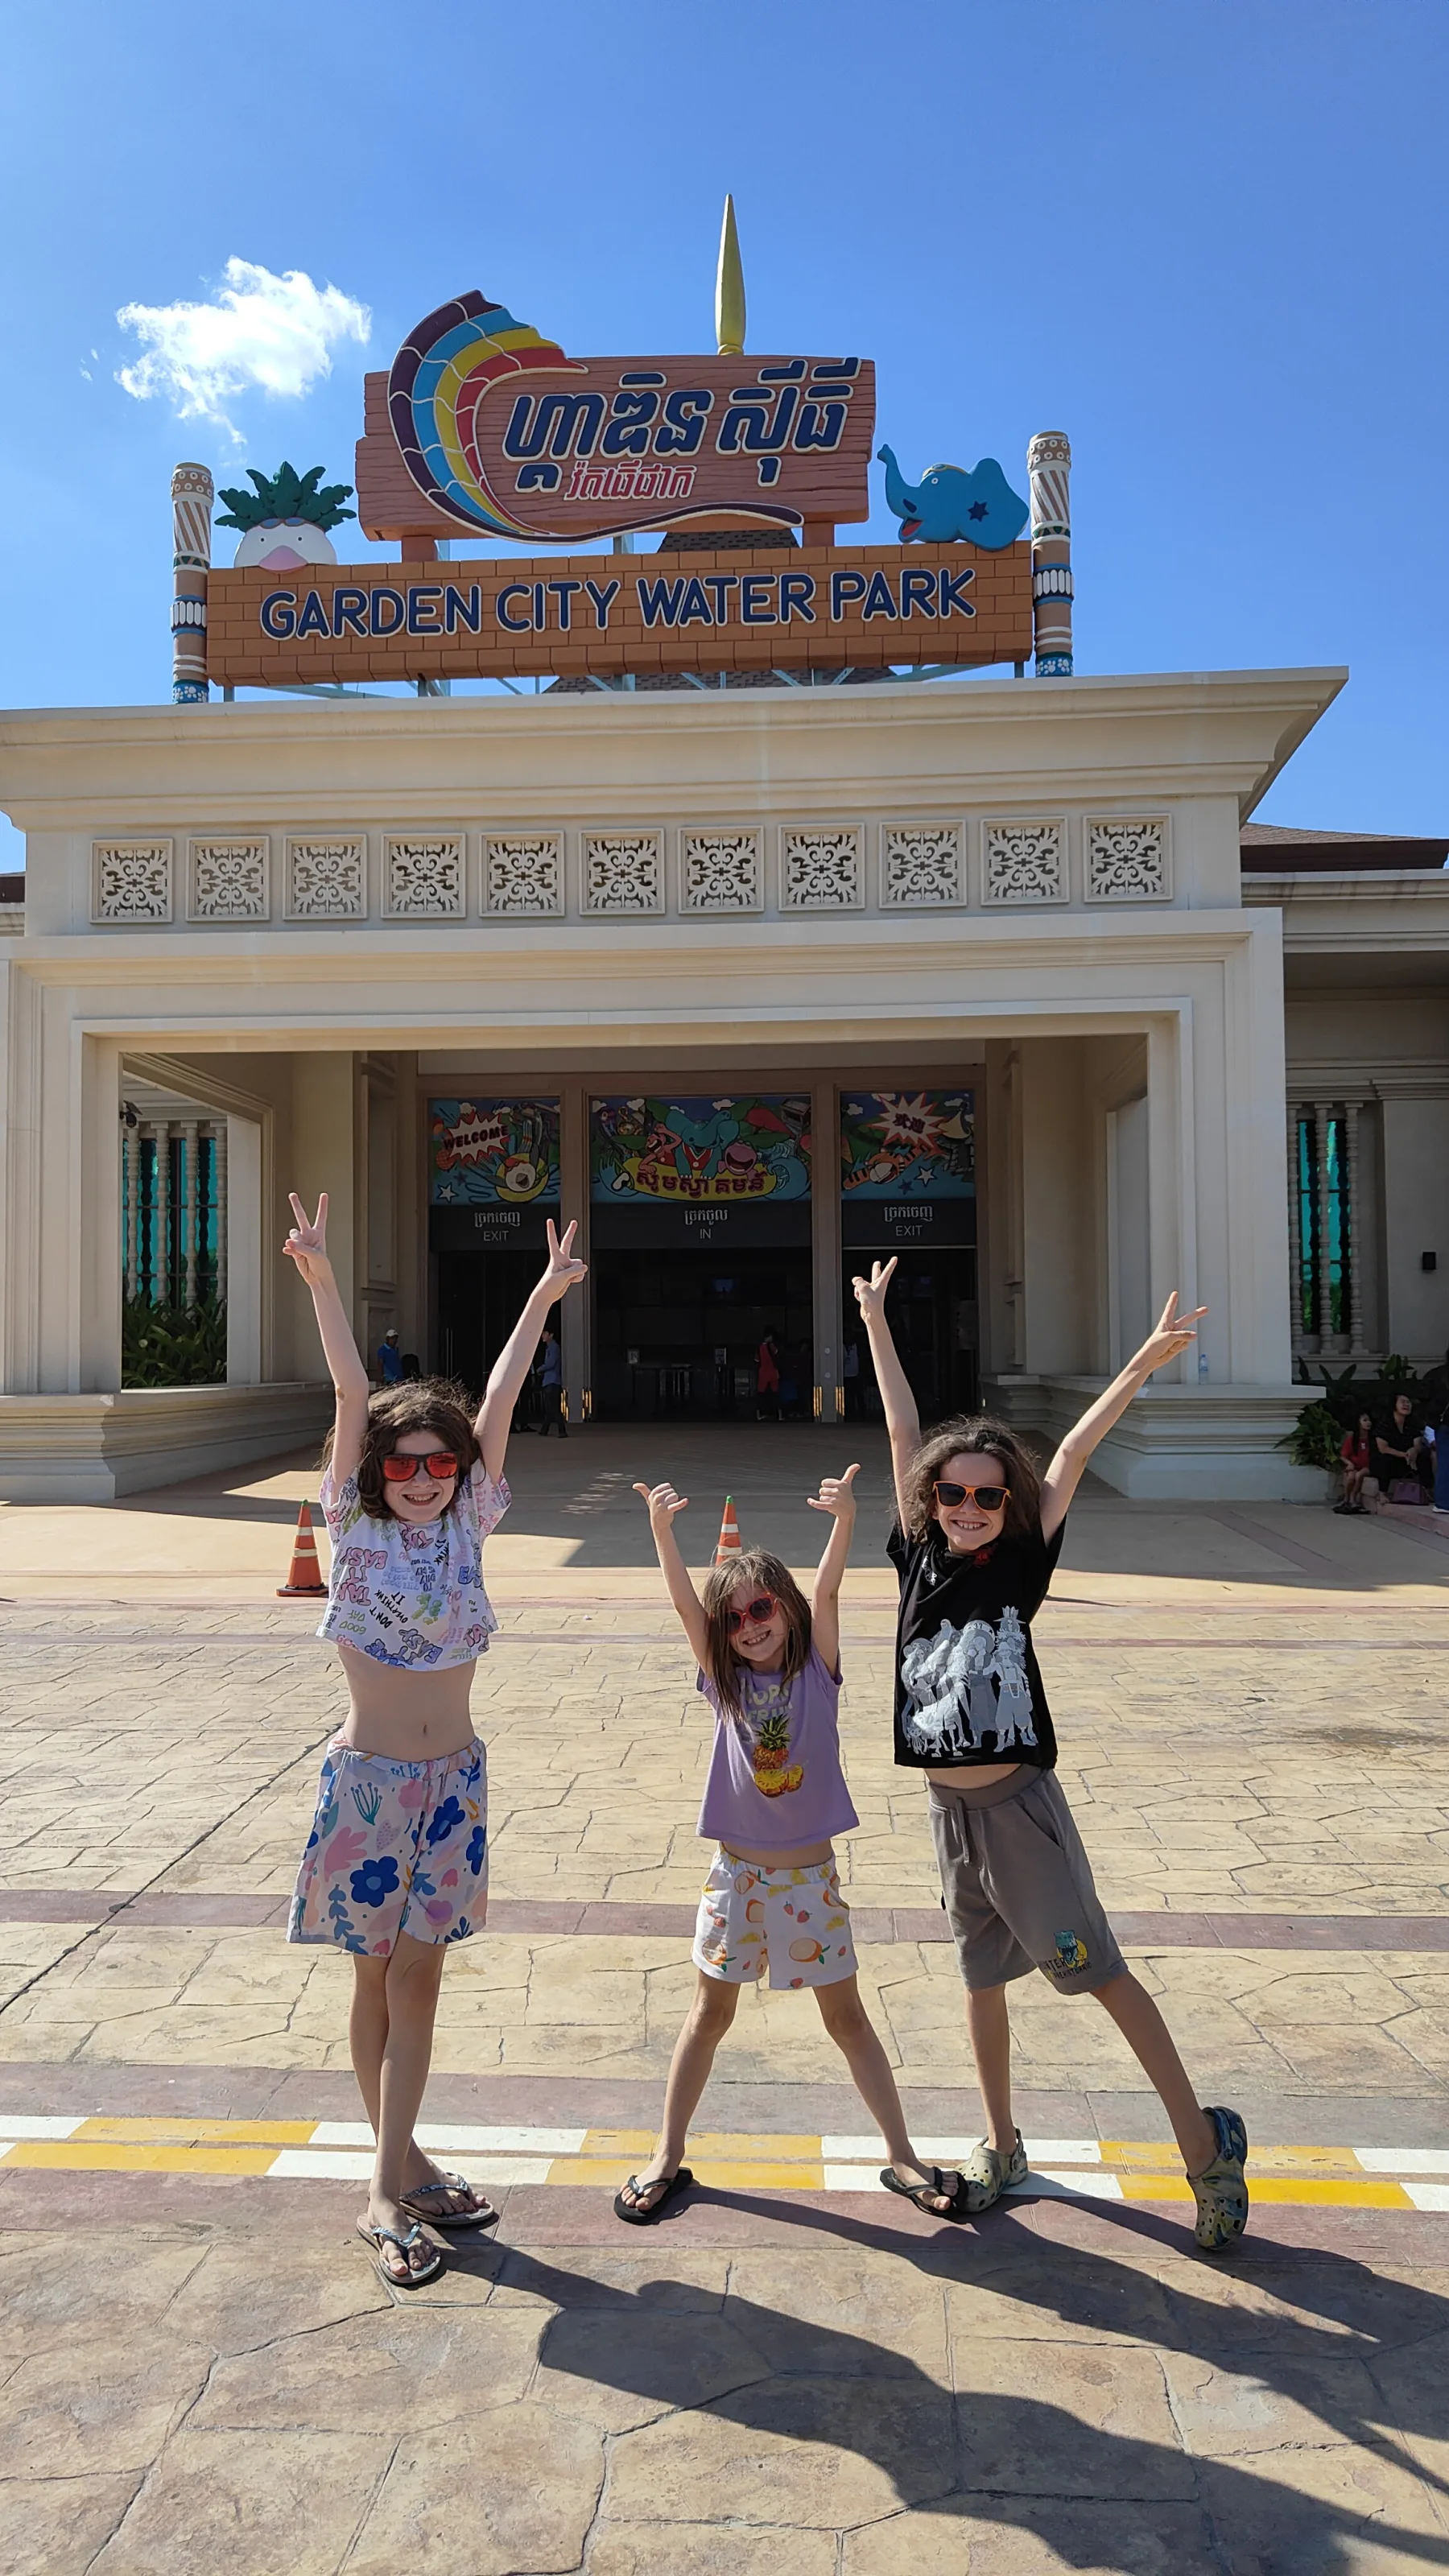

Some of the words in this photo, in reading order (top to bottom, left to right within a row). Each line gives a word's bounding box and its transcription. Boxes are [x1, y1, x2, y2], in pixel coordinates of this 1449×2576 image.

[260, 583, 481, 640] GARDEN
[496, 578, 621, 633] CITY
[636, 572, 816, 628] WATER
[830, 568, 976, 621] PARK
[443, 1125, 509, 1150] WELCOME
[483, 1230, 509, 1241] EXIT
[700, 1228, 712, 1239] IN
[895, 1225, 923, 1236] EXIT
[390, 1591, 406, 1605] IT
[374, 1590, 409, 1624] OVERTHINK
[369, 1606, 393, 1629] DON'T
[338, 1621, 367, 1635] GOOD
